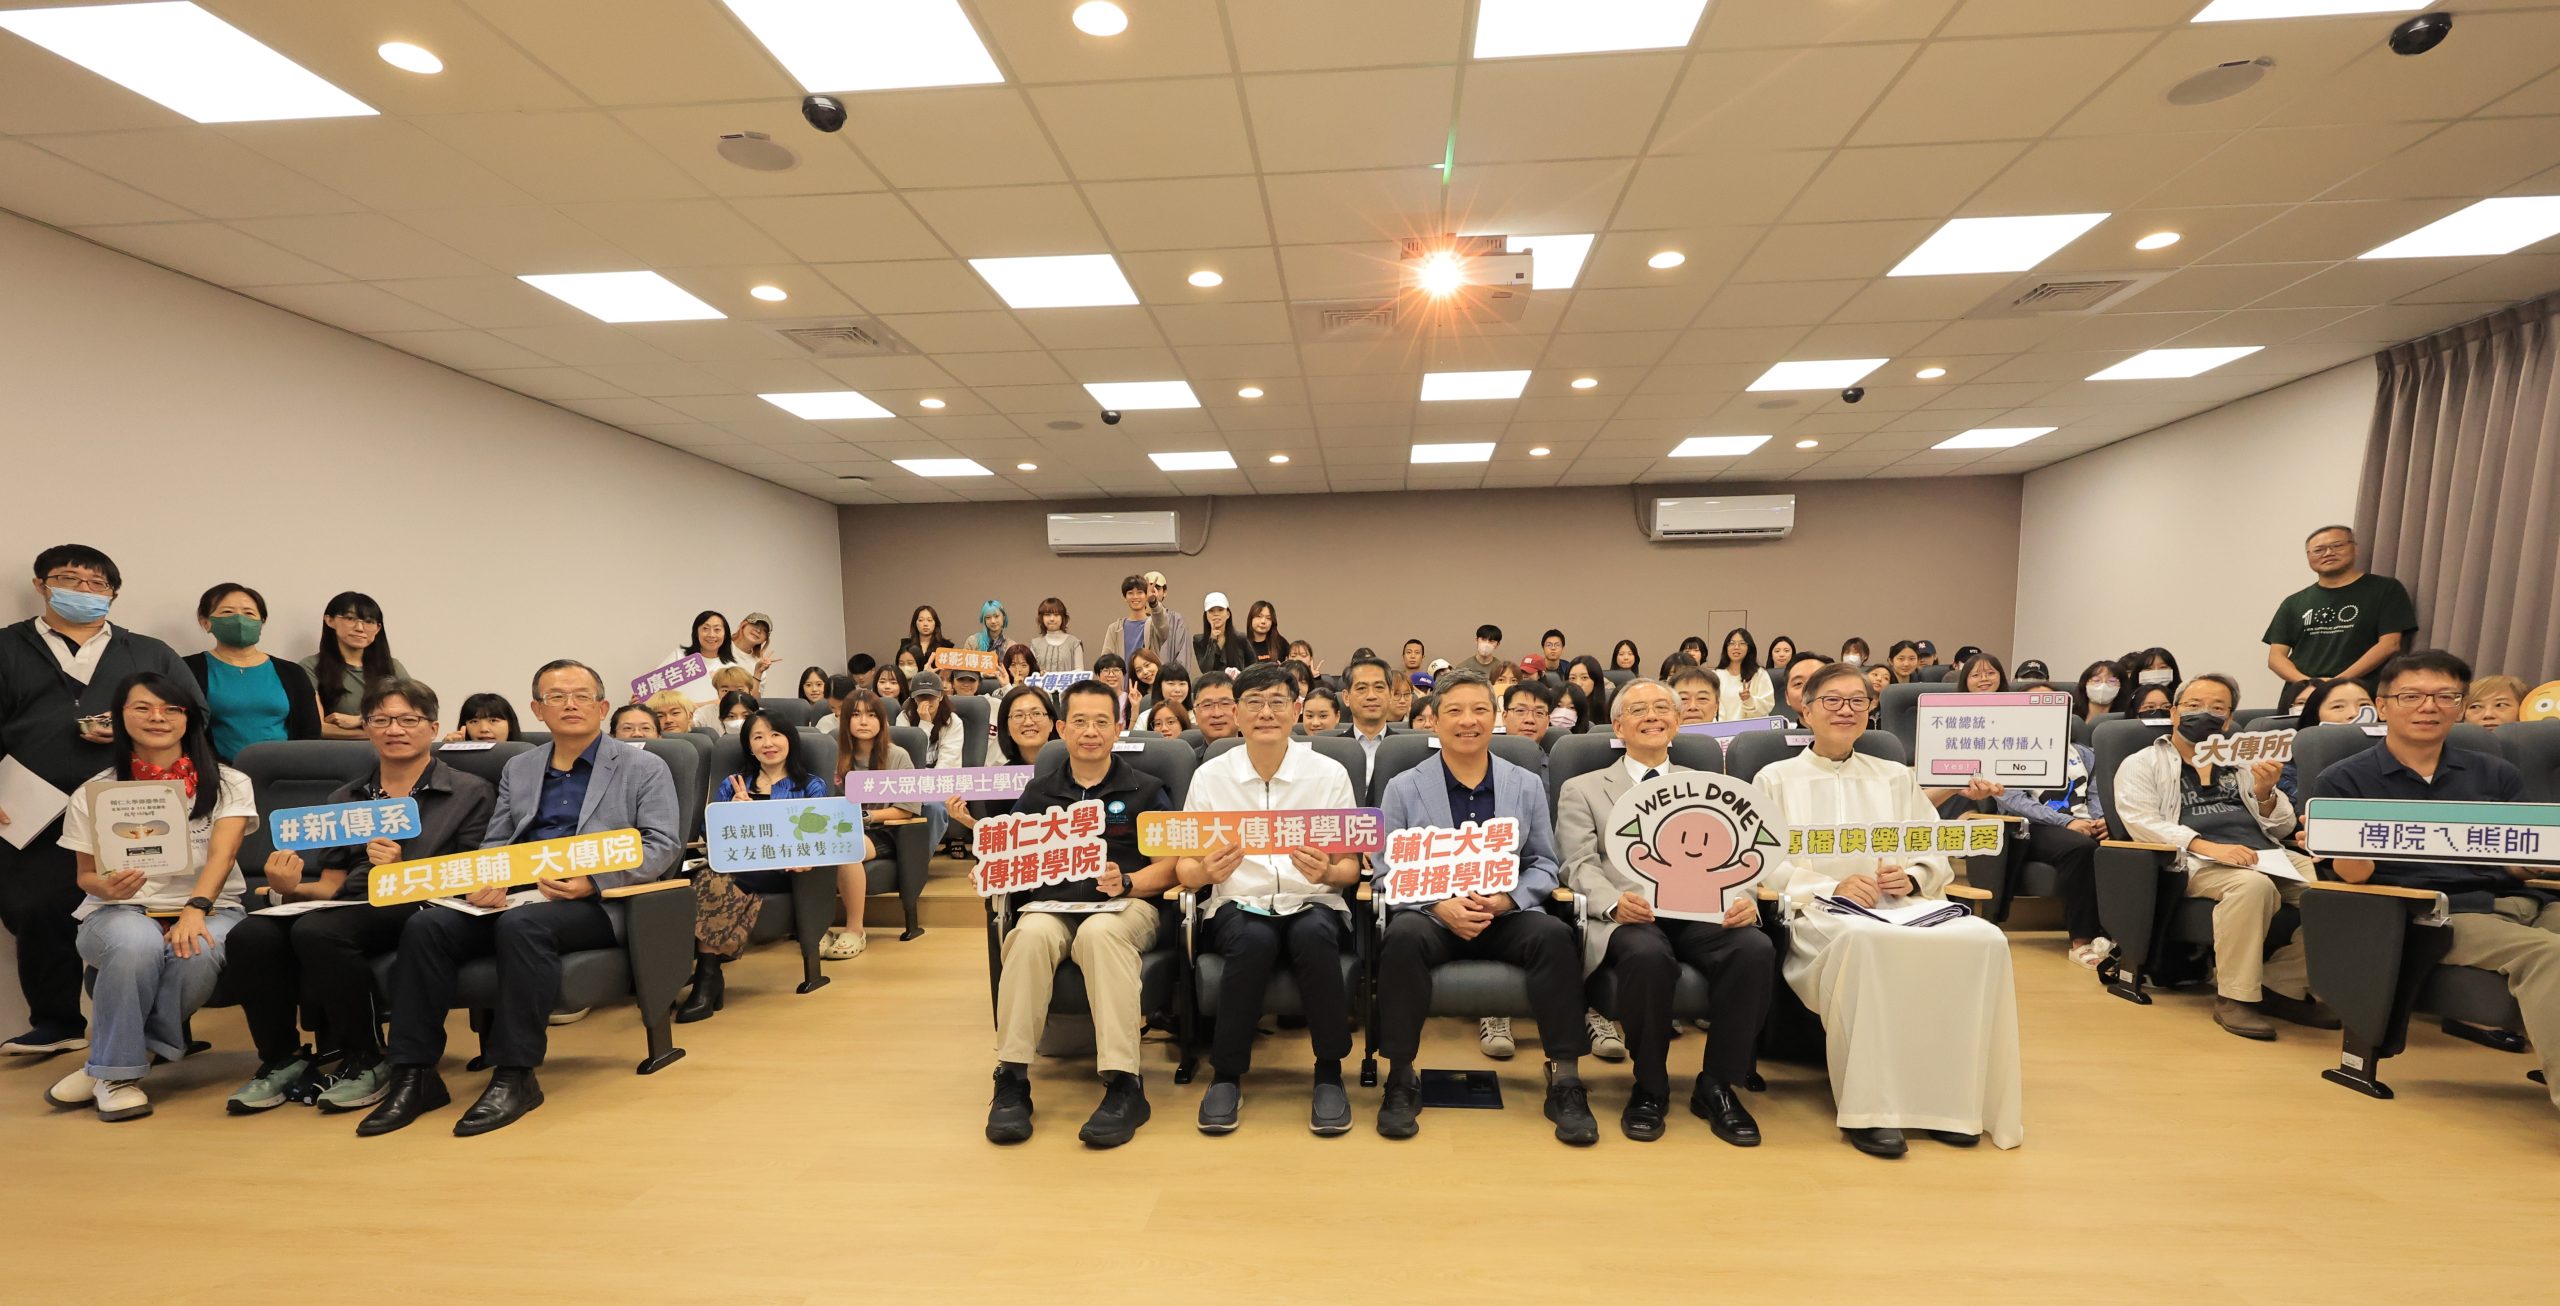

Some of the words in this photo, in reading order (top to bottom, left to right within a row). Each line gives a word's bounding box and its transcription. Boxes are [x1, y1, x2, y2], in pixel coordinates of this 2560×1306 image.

[636, 657, 702, 698] #廣告系
[939, 651, 994, 670] #影傳系
[1943, 763, 1970, 771] Yes!
[2012, 763, 2027, 771] No
[2198, 732, 2293, 763] 大傳所
[863, 772, 1034, 795] #大眾傳播學士學位
[279, 804, 412, 843] #新傳系
[1635, 782, 1699, 815] WELL
[1705, 783, 1759, 832] DONE
[978, 806, 1099, 855] 輔仁大學
[1145, 813, 1378, 849] #輔大傳播學院
[1390, 823, 1514, 864] 輔仁大學
[376, 852, 511, 898] #只選輔
[530, 834, 638, 877] 大傳院
[980, 842, 1101, 892] 傳播學院
[1389, 857, 1514, 899] 傳播學院
